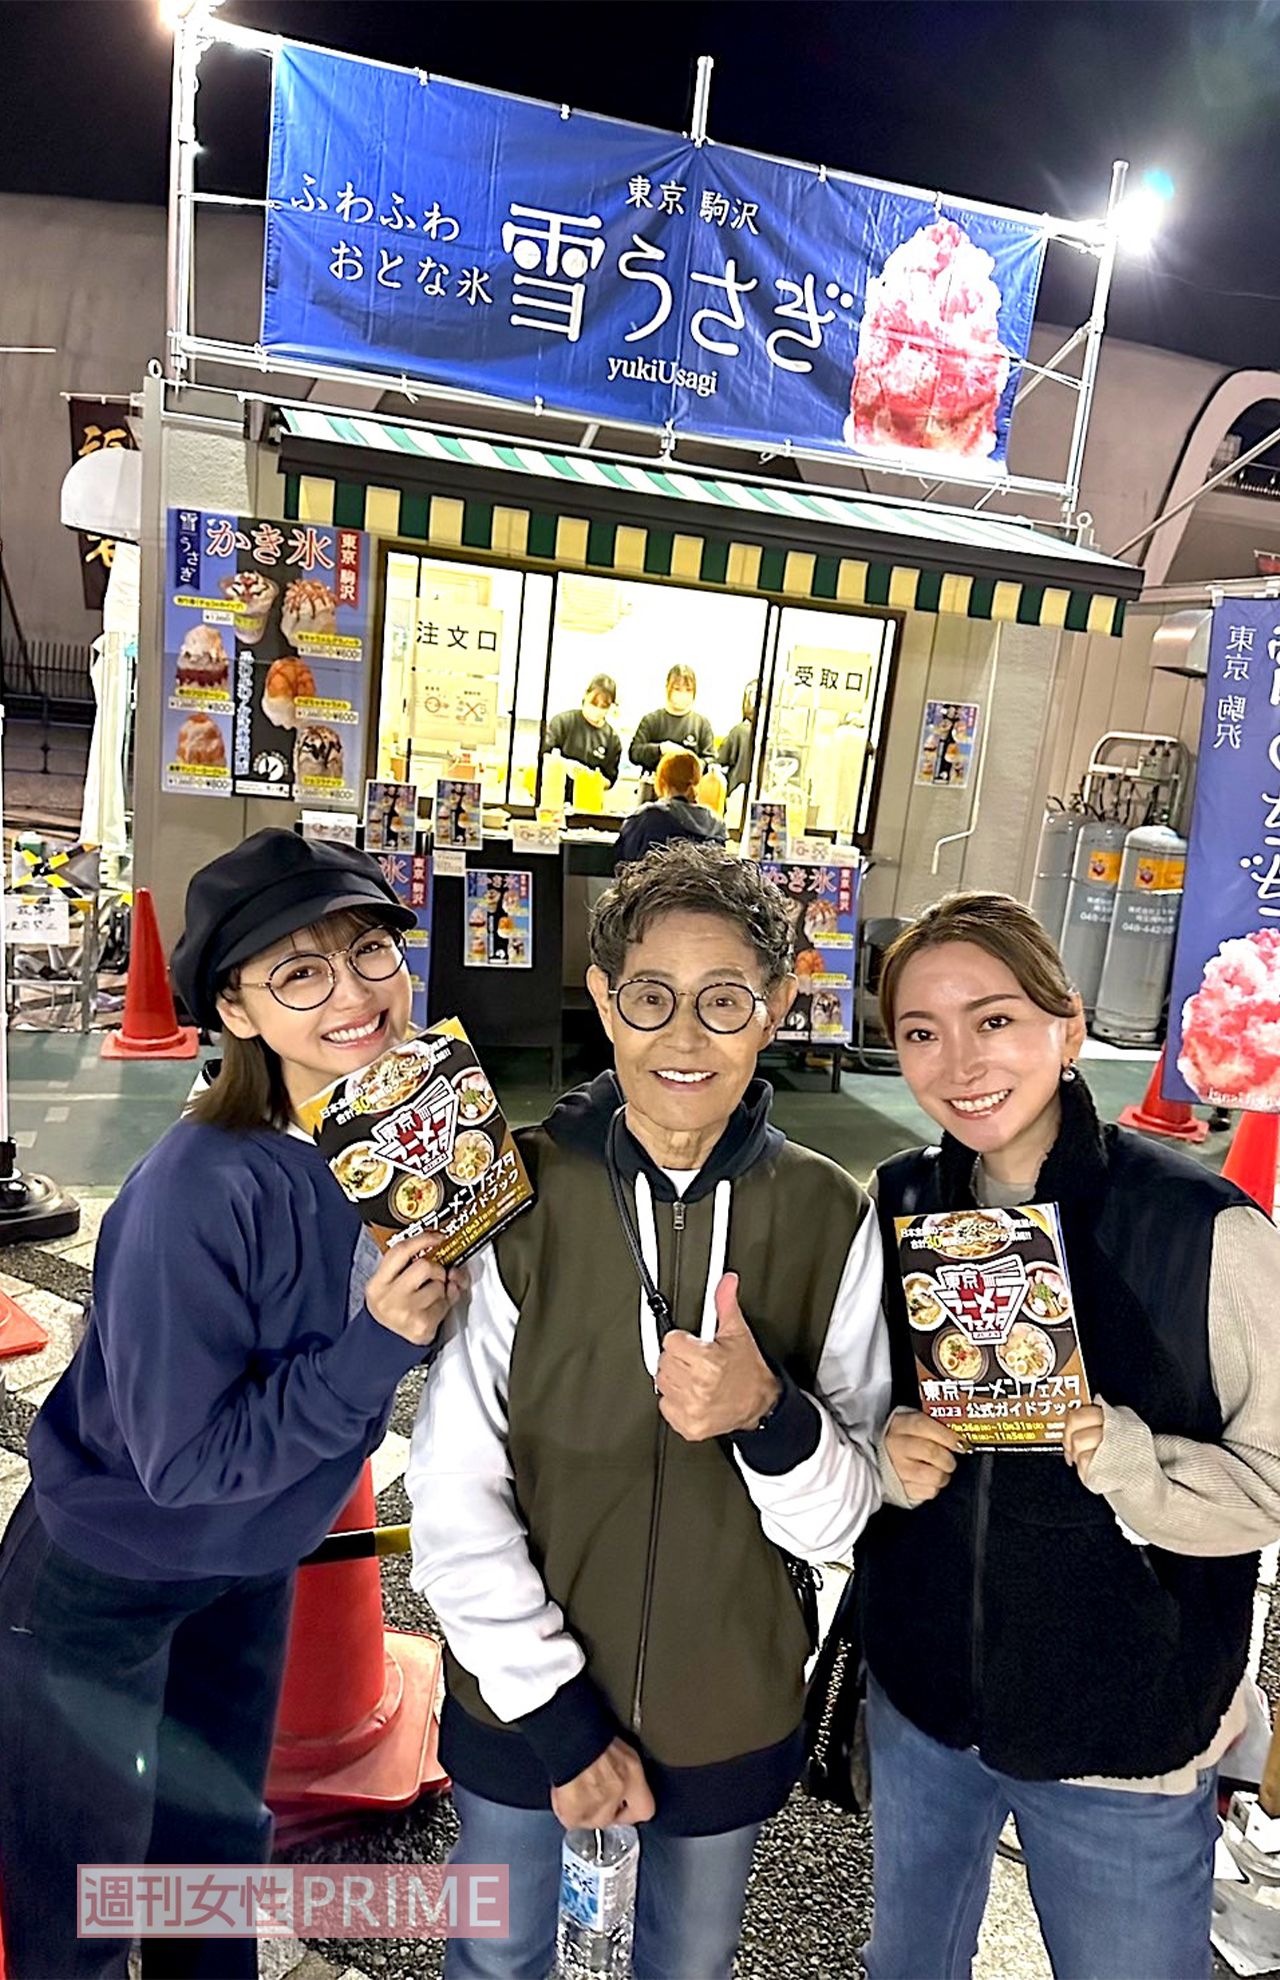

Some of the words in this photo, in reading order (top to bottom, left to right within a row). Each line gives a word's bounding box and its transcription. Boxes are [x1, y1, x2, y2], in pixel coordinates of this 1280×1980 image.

[288, 174, 463, 243] ふわふわ
[624, 175, 688, 216] 東京
[701, 191, 760, 236] 駒沢
[328, 241, 493, 305] おとな氷
[501, 203, 854, 373] 雪うさぎ
[606, 358, 720, 399] yukiUsagi
[204, 519, 336, 570] かき氷
[340, 533, 357, 565] 東京
[339, 569, 356, 601] 駒沢
[416, 621, 497, 651] 注文口
[794, 666, 862, 691] 受取口
[375, 1101, 453, 1161] ラーメン
[378, 1113, 416, 1142] 東京
[404, 1131, 450, 1170] フェスタ
[942, 1270, 979, 1290] 東京
[935, 1285, 1023, 1315] ラーメン
[957, 1312, 1011, 1331] フェスタ
[920, 1375, 1080, 1401] 東京ラーメンフェスタ
[929, 1406, 962, 1417] 2023
[967, 1399, 1082, 1418] 公式ガイドブック
